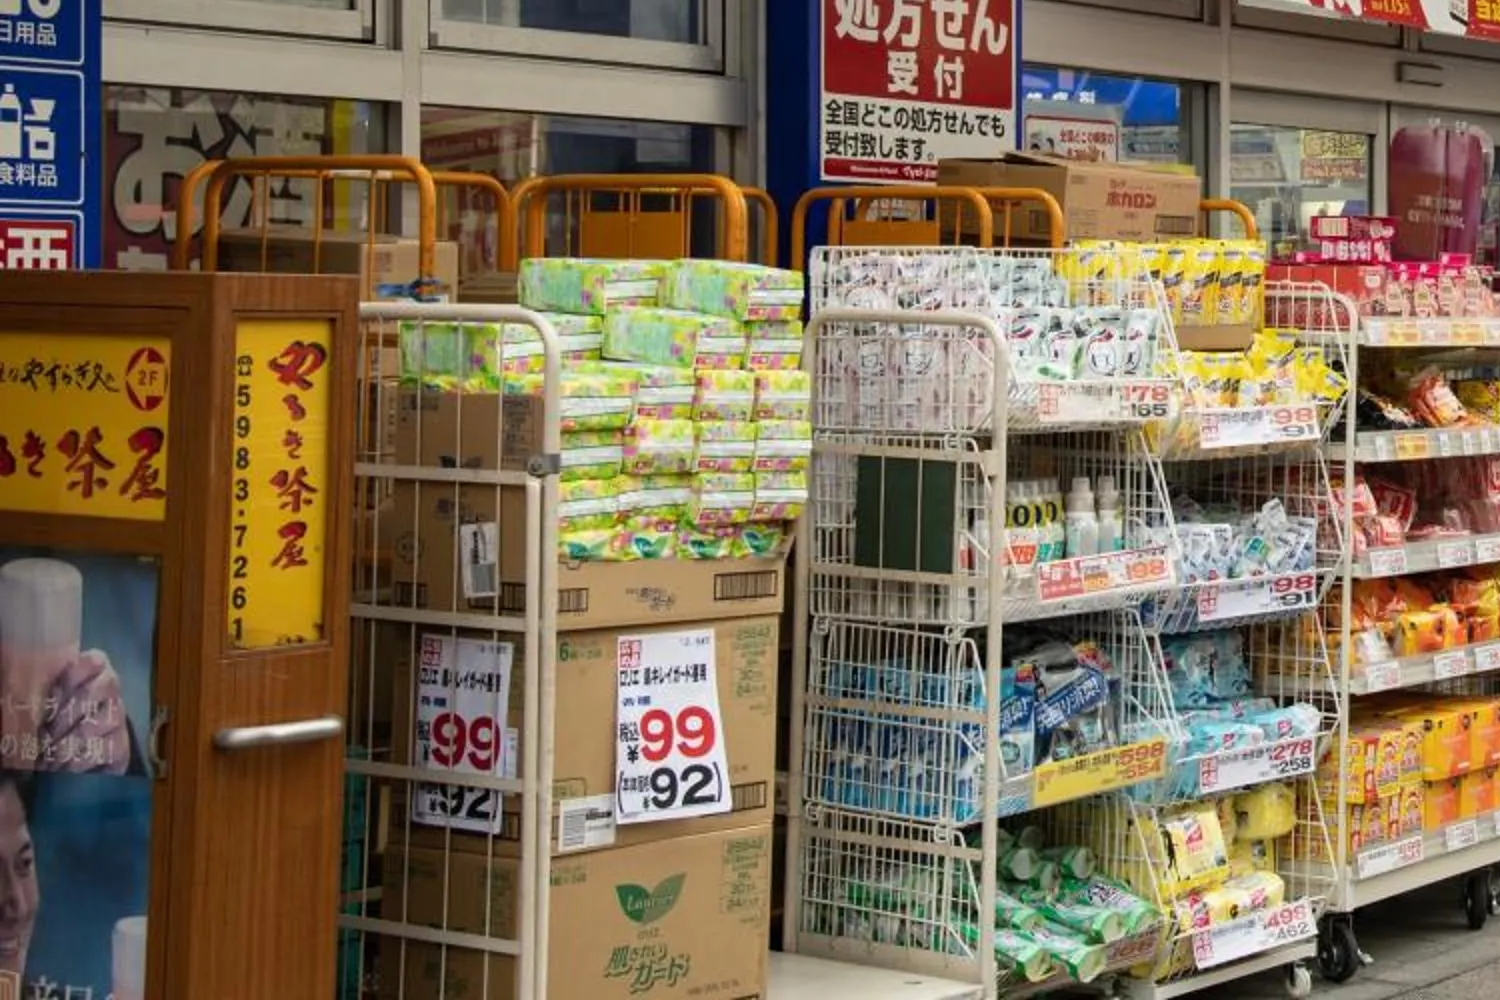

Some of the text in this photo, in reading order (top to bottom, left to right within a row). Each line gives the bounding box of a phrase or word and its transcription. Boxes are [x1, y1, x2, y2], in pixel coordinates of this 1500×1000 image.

[886, 51, 965, 100] 受付
[825, 99, 1006, 138] 全国どこの処方せんでも
[825, 130, 936, 162] 受付致します。
[137, 369, 158, 386] 2F
[431, 711, 501, 772] 99
[1272, 739, 1313, 761] 278
